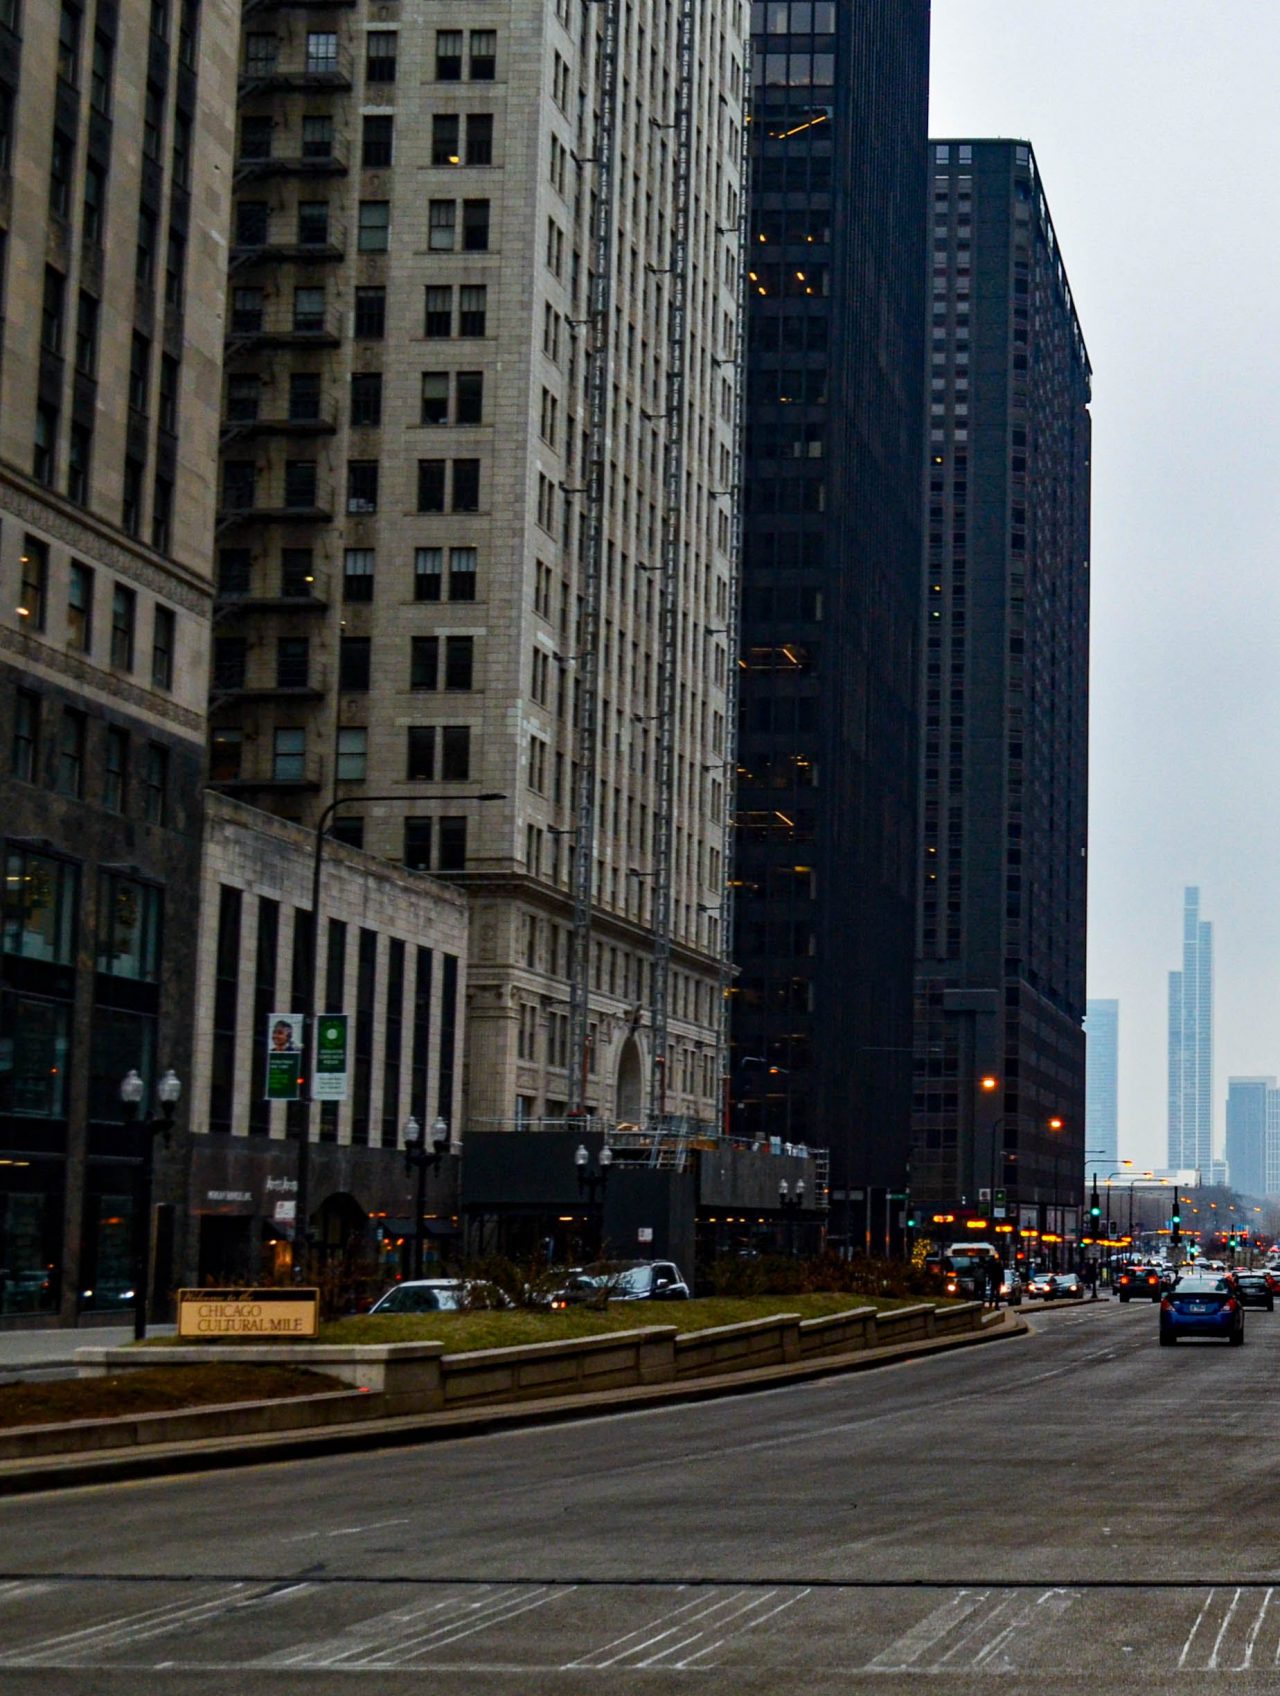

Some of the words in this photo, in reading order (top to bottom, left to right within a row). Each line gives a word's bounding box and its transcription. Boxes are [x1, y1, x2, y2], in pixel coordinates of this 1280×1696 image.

[198, 1304, 262, 1318] CHICAGO
[197, 1318, 268, 1332] CULTURAL
[269, 1318, 303, 1332] MILE
